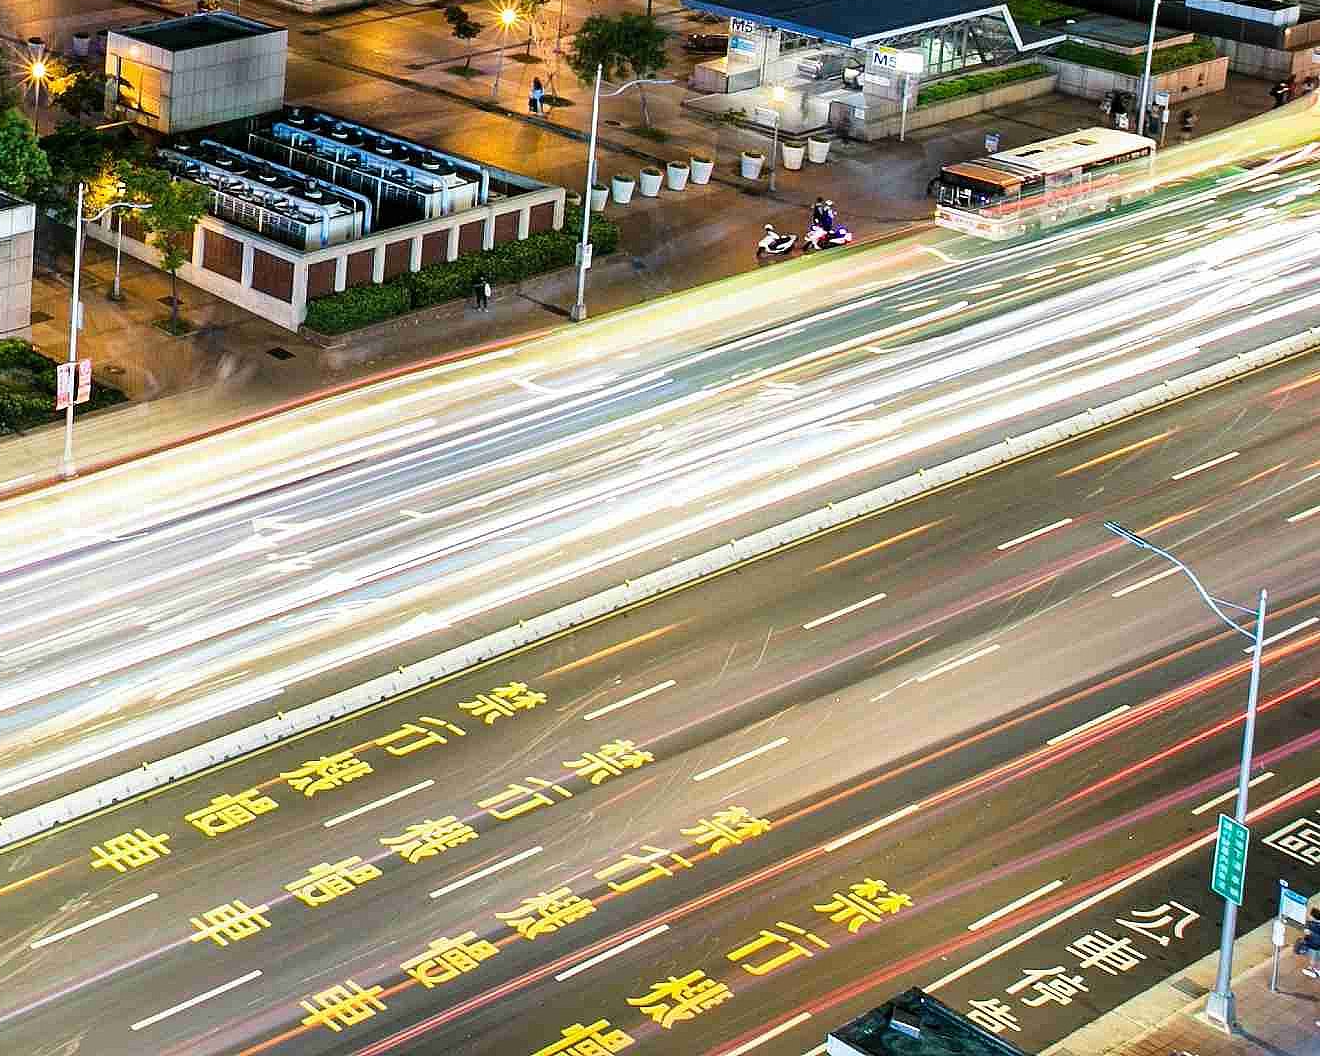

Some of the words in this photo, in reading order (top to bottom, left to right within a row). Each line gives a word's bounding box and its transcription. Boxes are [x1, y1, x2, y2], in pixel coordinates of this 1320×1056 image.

[90, 680, 548, 874] 禁行機慢車
[190, 739, 655, 947] 禁行機慢車
[301, 805, 772, 1032] 禁行機慢車
